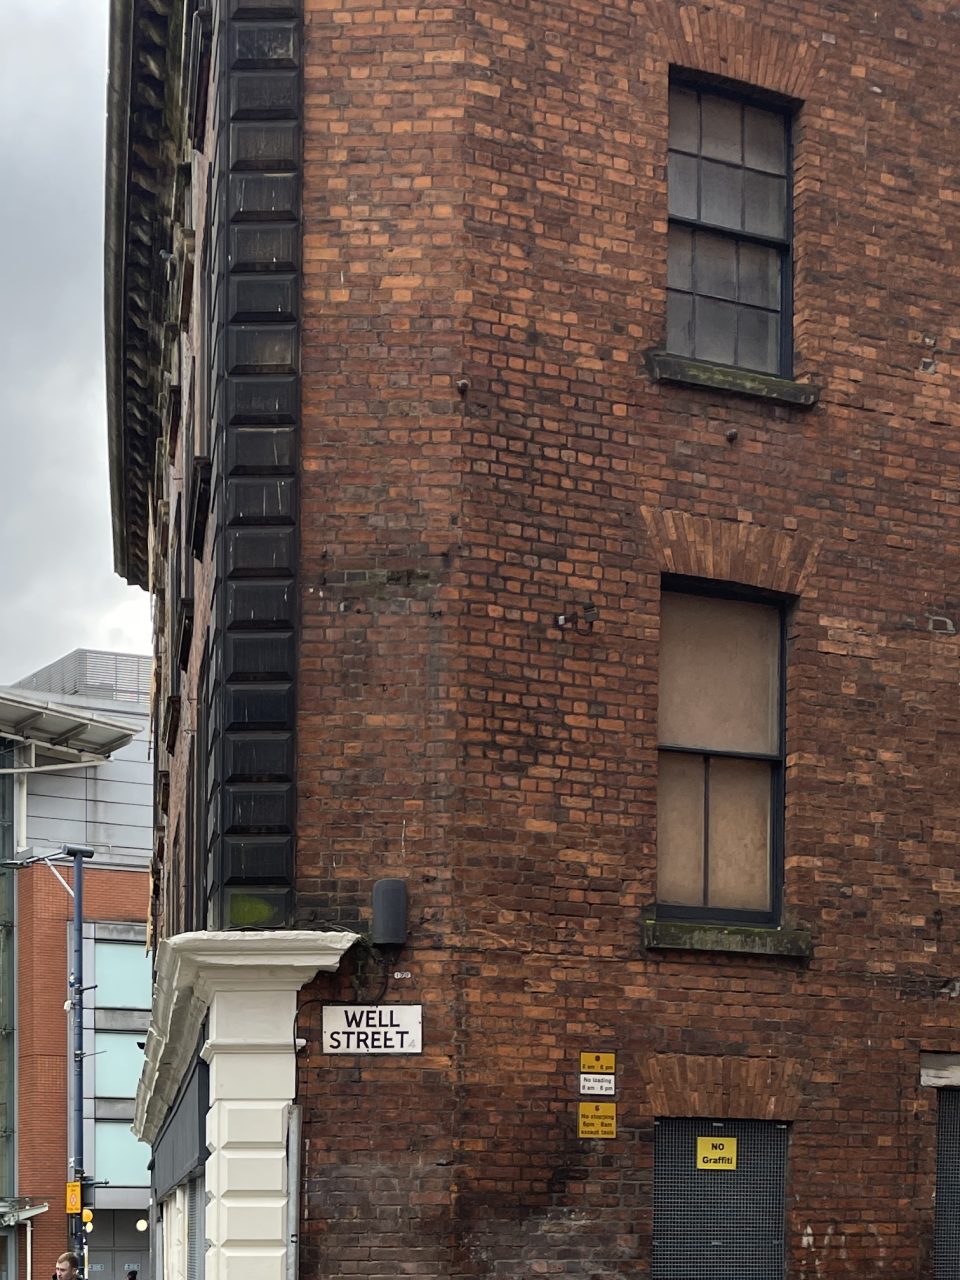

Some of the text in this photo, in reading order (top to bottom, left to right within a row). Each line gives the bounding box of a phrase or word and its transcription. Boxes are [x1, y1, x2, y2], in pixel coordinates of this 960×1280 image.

[344, 1010, 400, 1028] WELL
[329, 1031, 409, 1049] STREET
[702, 1156, 733, 1164] Graffiti
